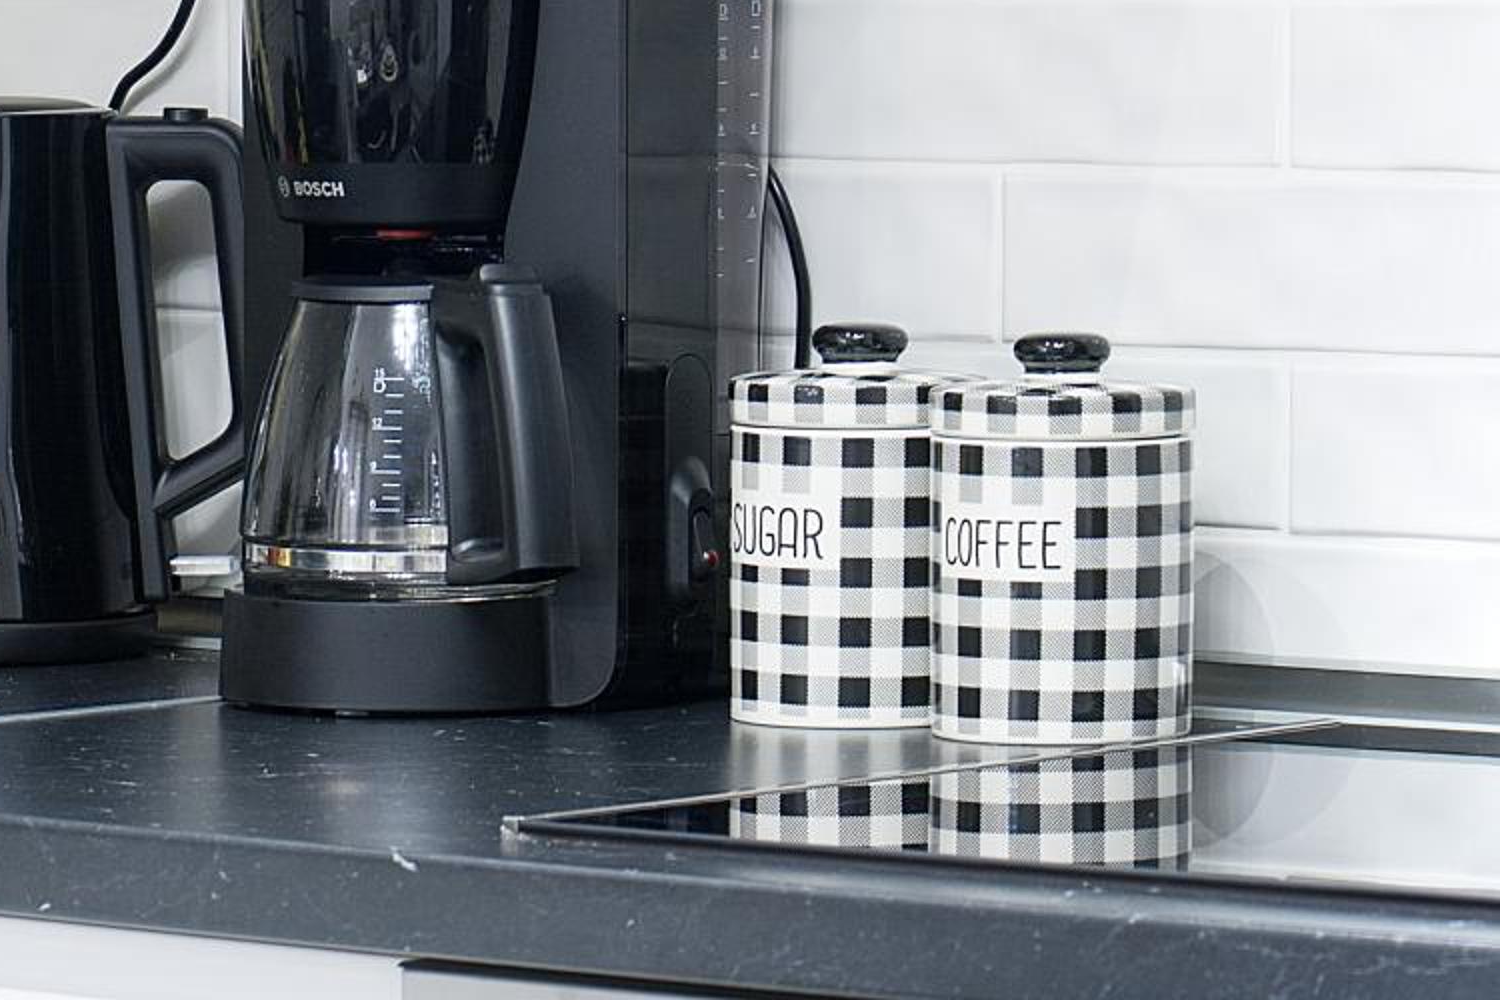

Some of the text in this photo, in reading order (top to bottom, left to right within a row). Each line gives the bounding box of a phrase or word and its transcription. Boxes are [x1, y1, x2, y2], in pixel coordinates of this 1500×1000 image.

[293, 181, 345, 197] BOSCH
[733, 502, 824, 560] SUGAR
[945, 517, 1062, 570] COFFEE
